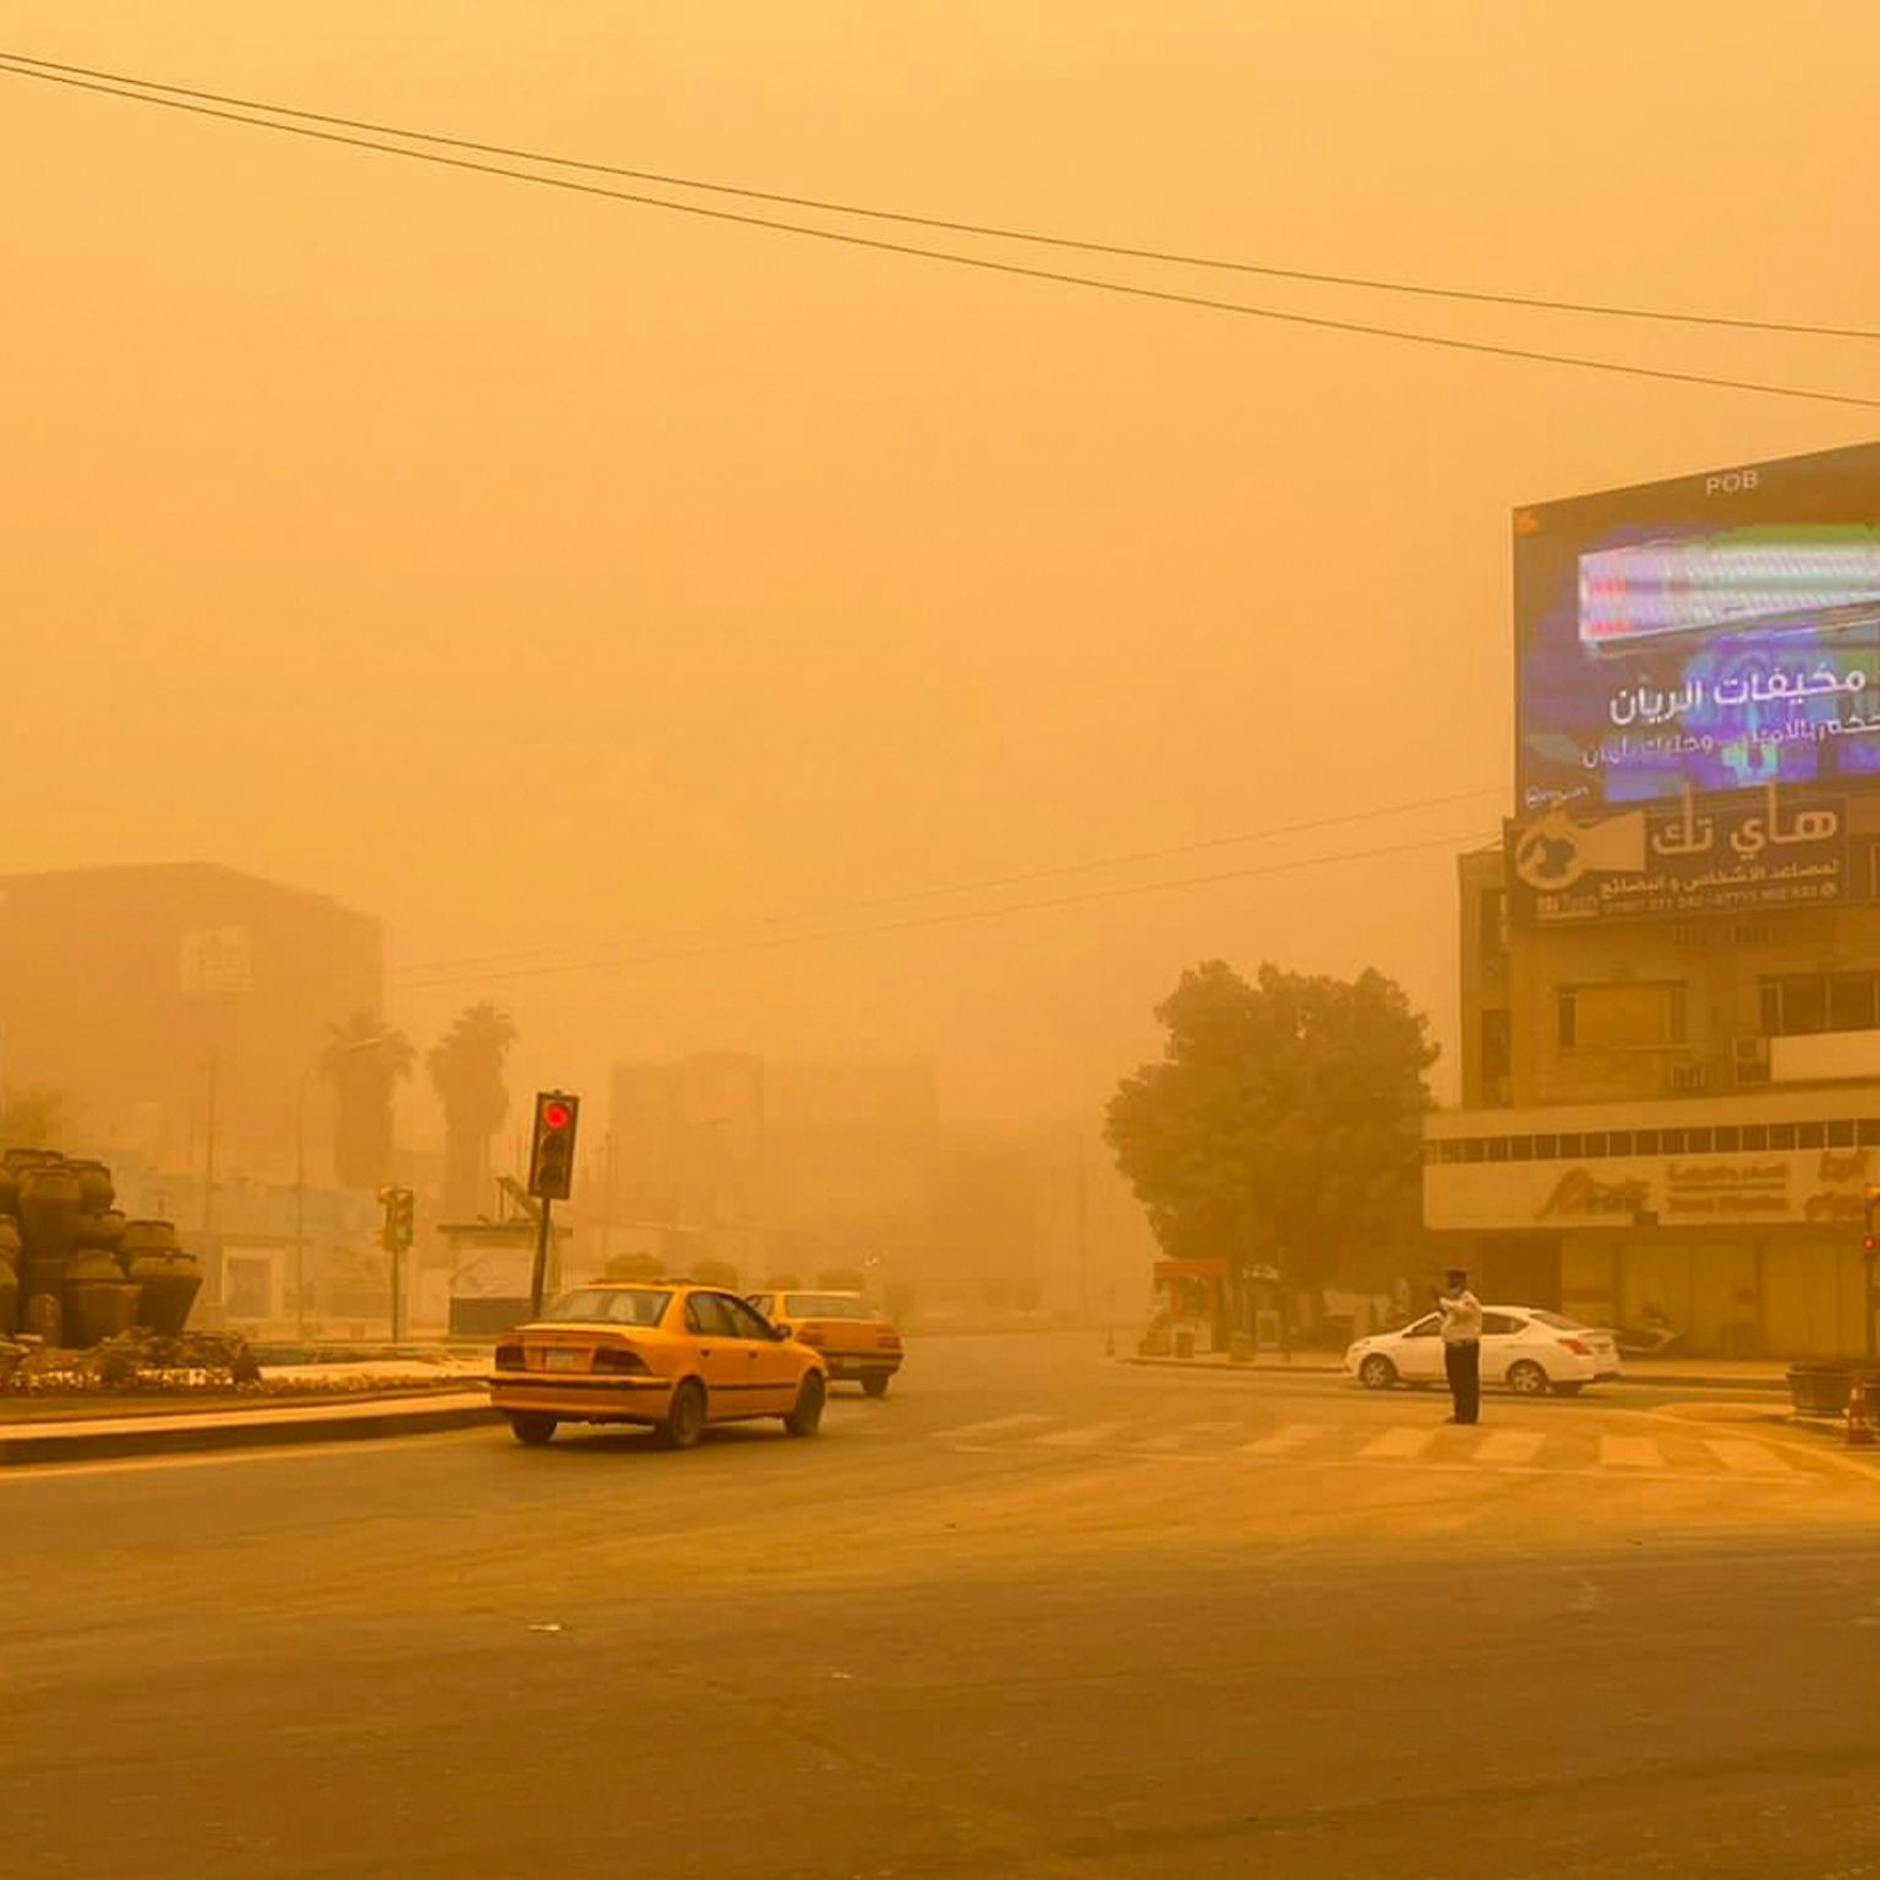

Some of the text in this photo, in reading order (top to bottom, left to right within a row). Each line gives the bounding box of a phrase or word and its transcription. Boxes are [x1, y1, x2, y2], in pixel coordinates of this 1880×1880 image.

[1609, 680, 1702, 726] الريان
[1652, 782, 1839, 860] هاي تك
